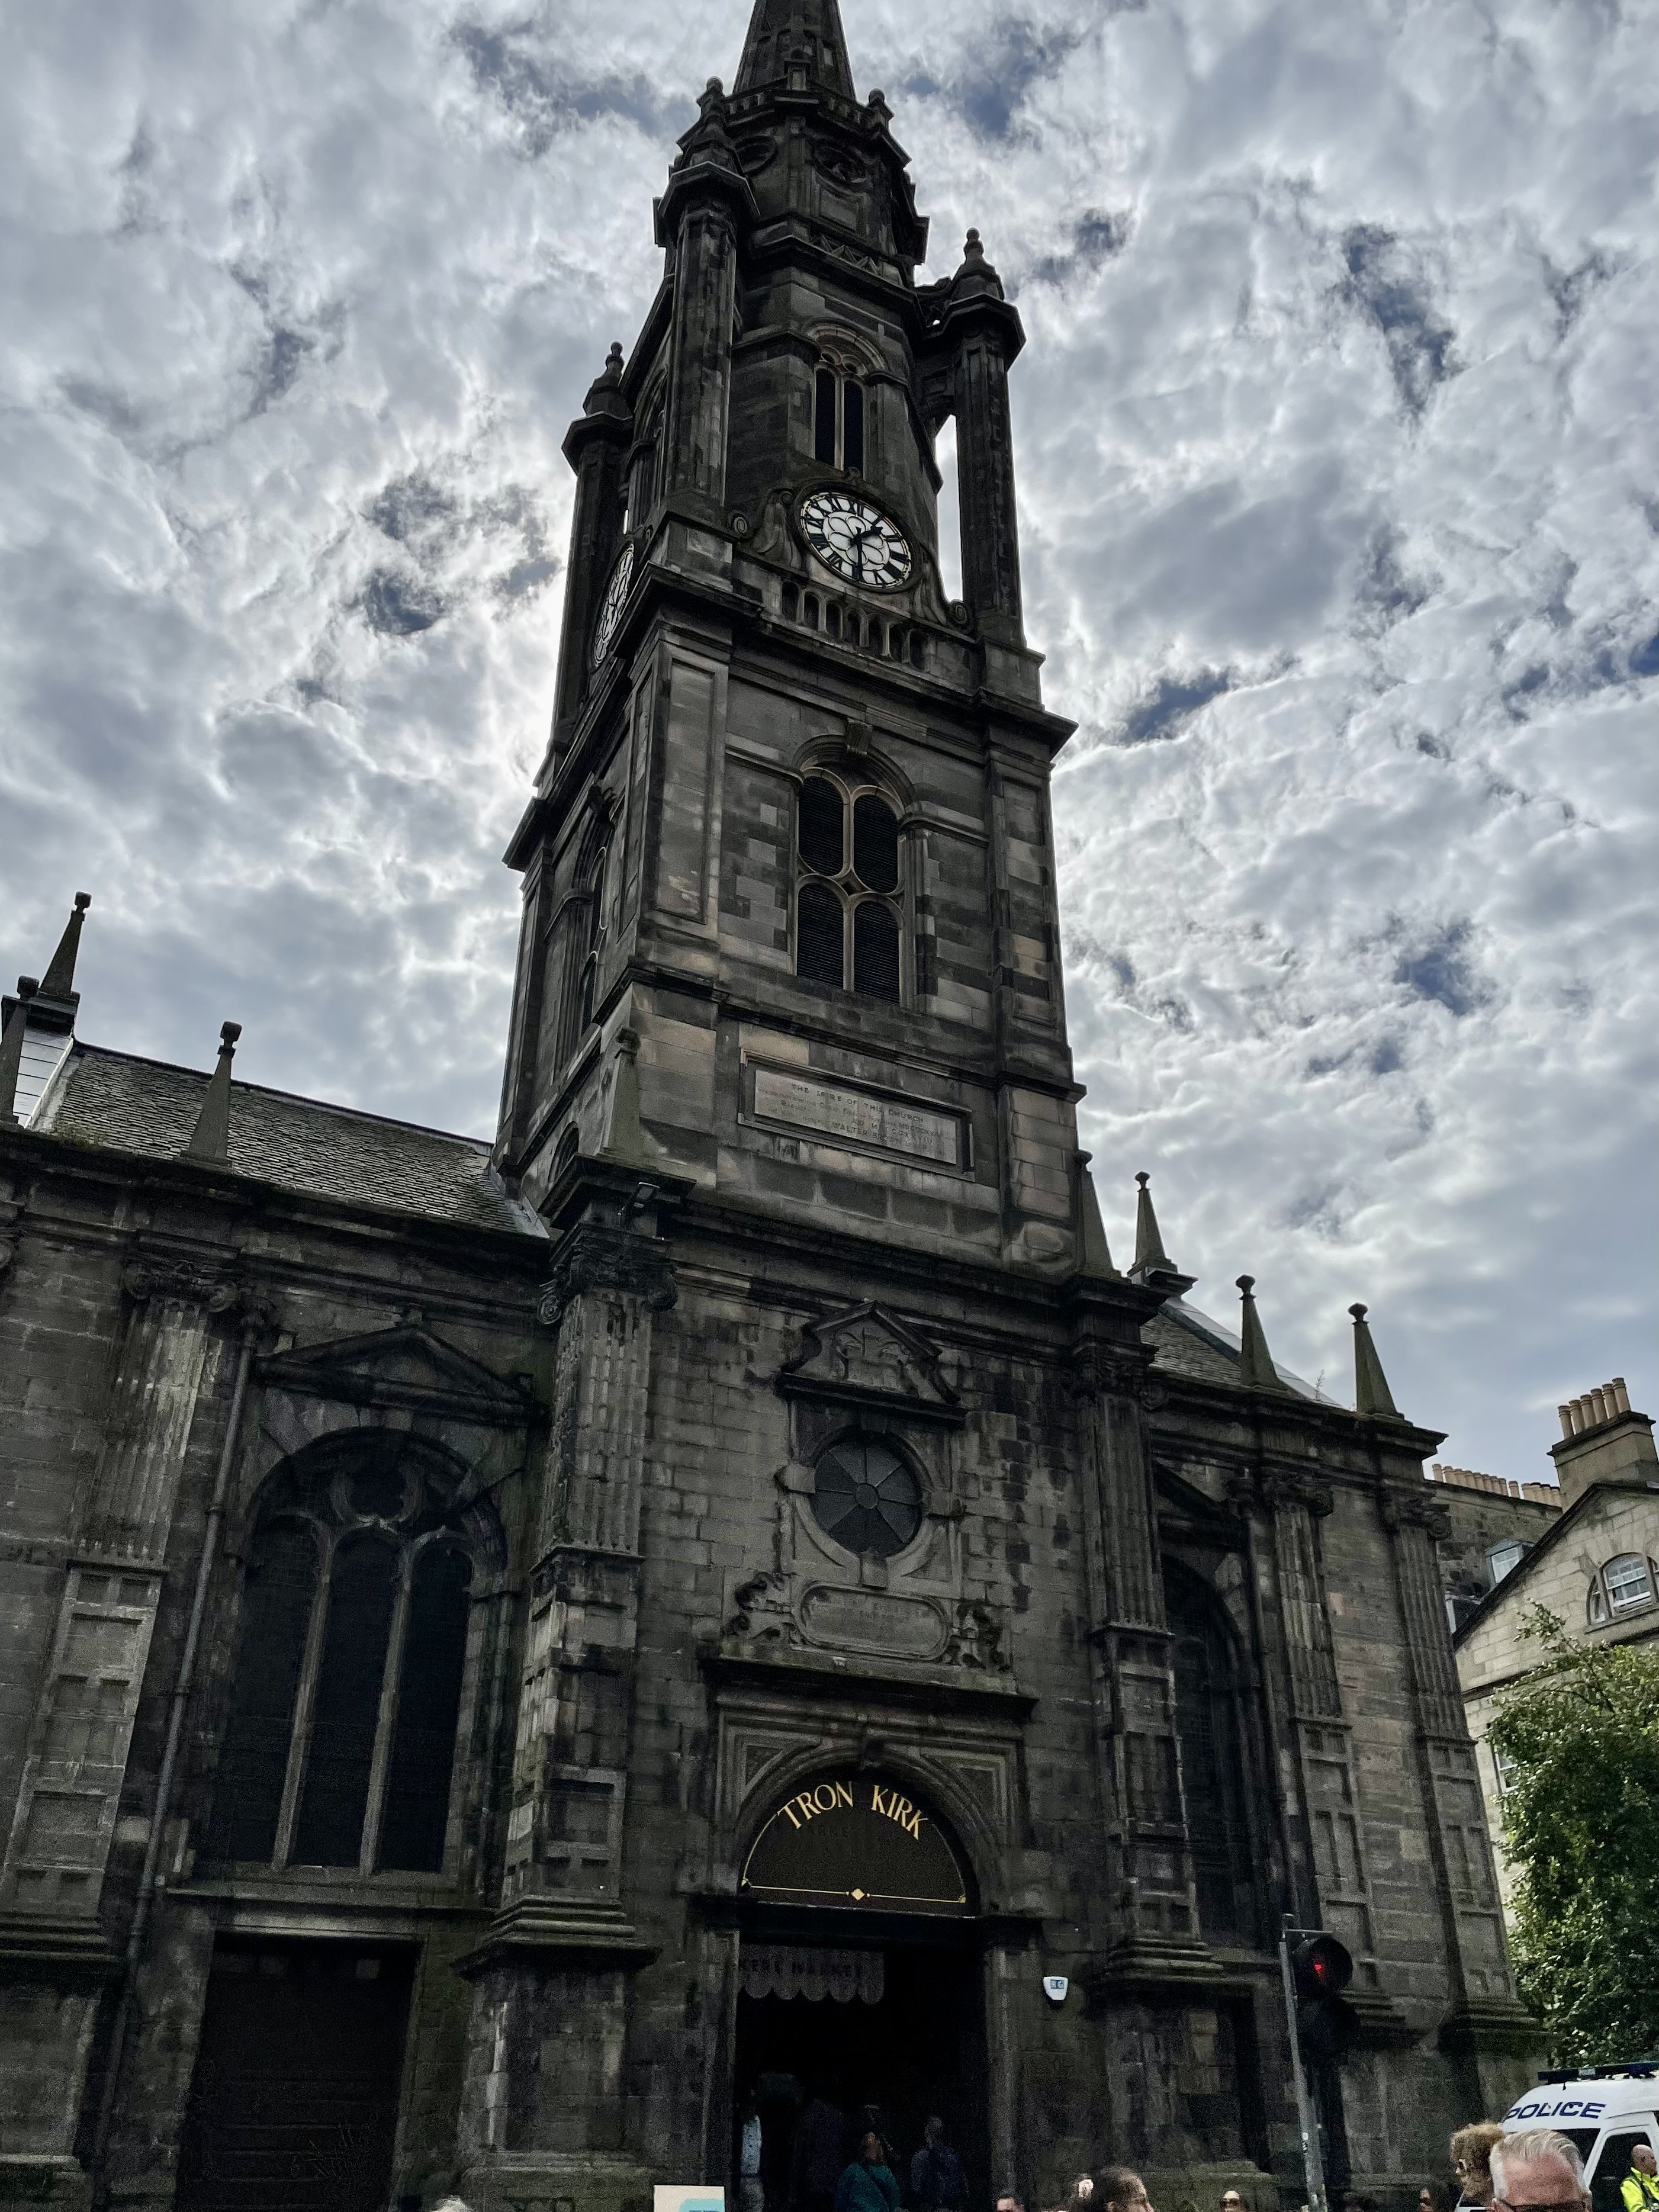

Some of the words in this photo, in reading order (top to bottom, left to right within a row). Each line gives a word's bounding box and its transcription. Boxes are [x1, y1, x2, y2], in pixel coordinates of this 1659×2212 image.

[791, 1084, 809, 1094] THE
[816, 1090, 841, 1102] SPIRE
[864, 1102, 883, 1114] THIS
[888, 1109, 924, 1123] CHURCH
[832, 1122, 868, 1136] WALTER
[872, 1132, 900, 1145] BROWN
[777, 1780, 854, 1830] TRON
[870, 1784, 928, 1840] KIRK
[1504, 2101, 1606, 2120] POLICE
